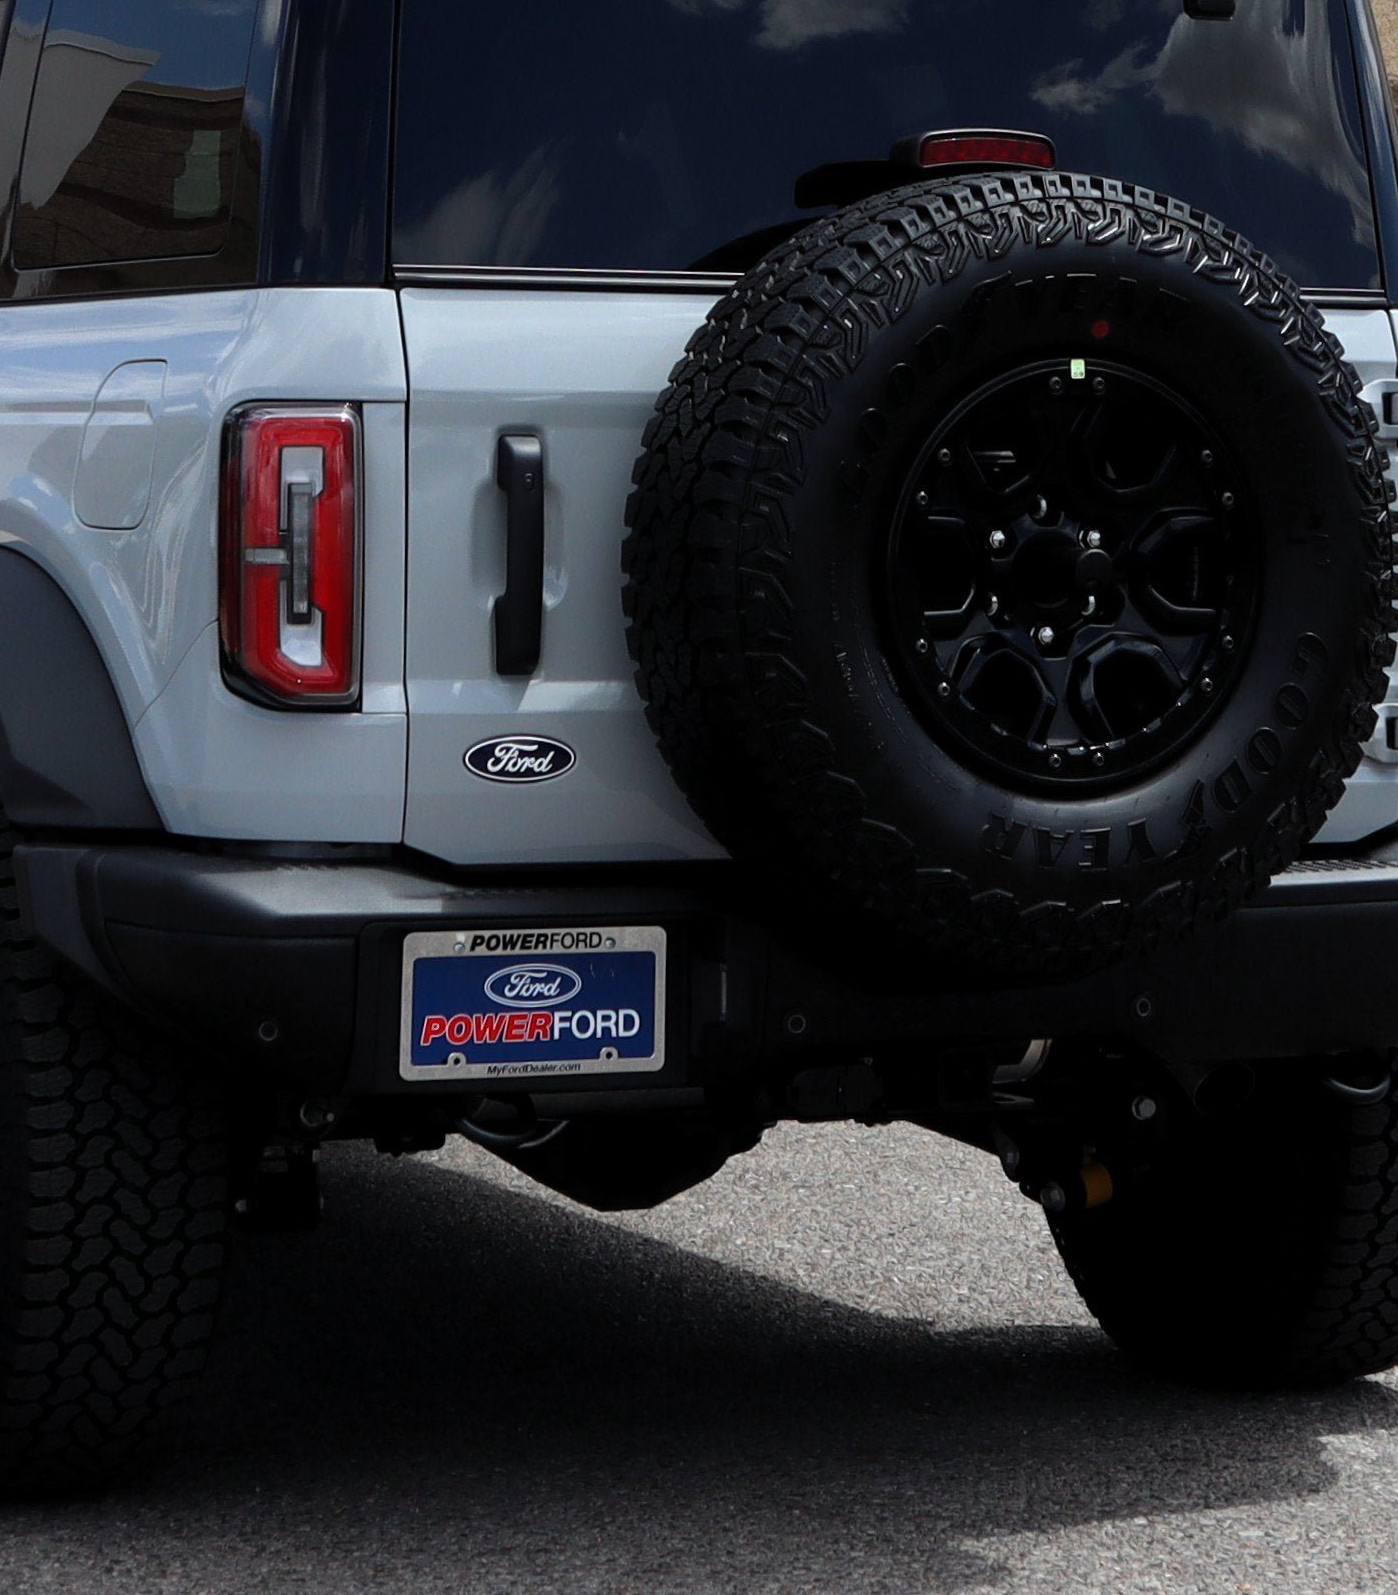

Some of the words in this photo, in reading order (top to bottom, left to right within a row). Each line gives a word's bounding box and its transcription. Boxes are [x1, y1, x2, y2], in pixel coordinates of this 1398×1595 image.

[486, 743, 556, 773] Ford
[469, 931, 603, 952] POWERFORD
[504, 971, 562, 998] Ford
[420, 1009, 641, 1047] POWERFORD
[486, 1062, 582, 1076] MyFordDealer.com
